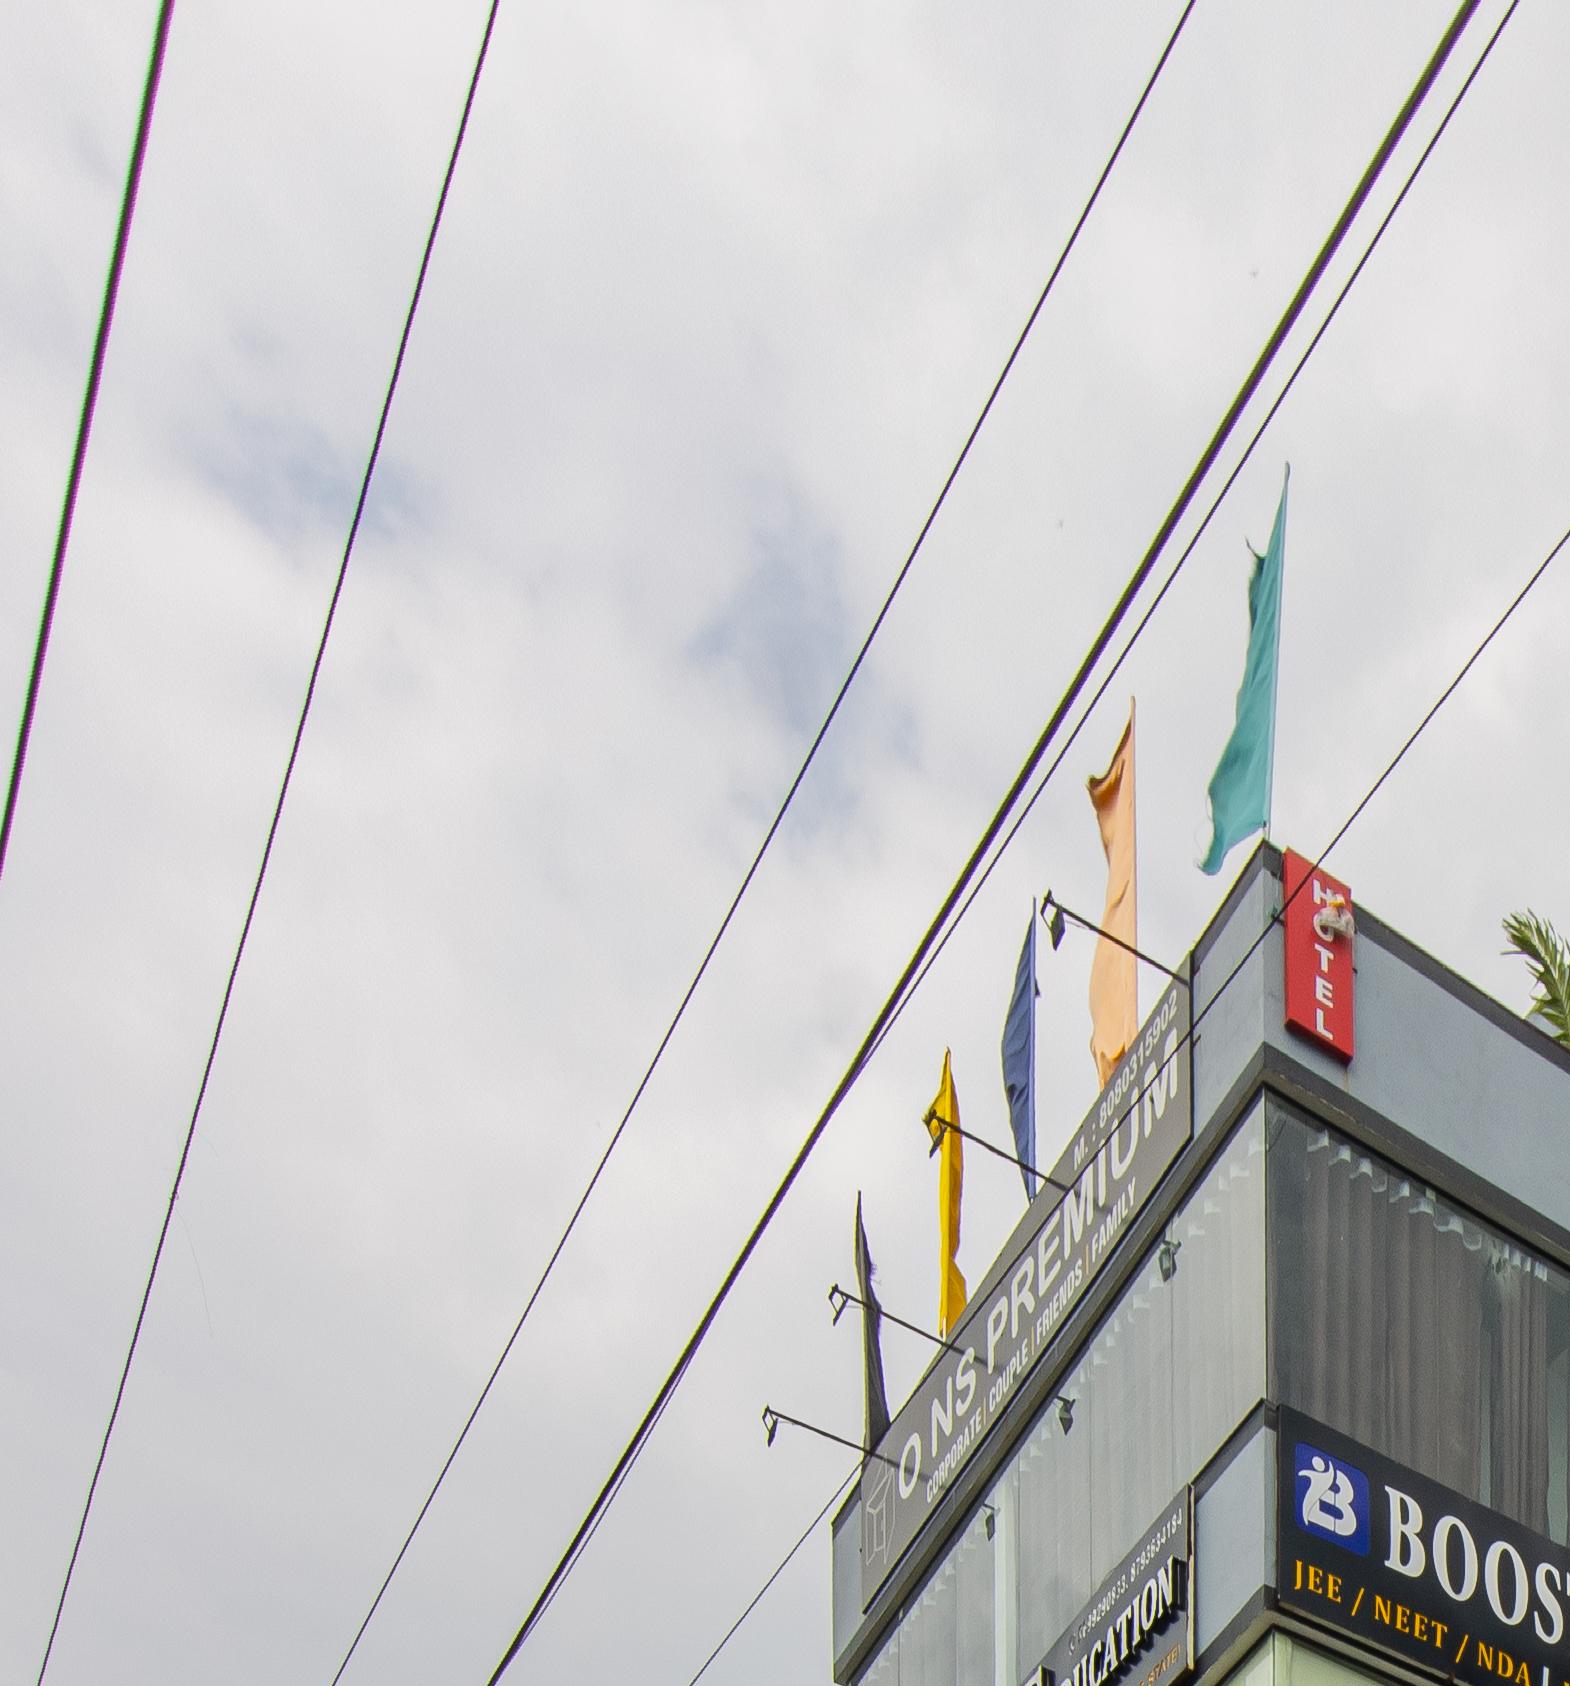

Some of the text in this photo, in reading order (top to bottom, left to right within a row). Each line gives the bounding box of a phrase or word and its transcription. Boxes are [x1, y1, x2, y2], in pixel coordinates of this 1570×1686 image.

[1313, 879, 1334, 1041] HOTEL
[1099, 989, 1177, 1130] 8080315902
[898, 1027, 1177, 1499] O NS PREMIUM
[927, 1176, 1136, 1503] CORPORATE COUPLE FRIENDS FAMILY
[1294, 1559, 1342, 1603] JEE
[1374, 1595, 1448, 1648] NEET
